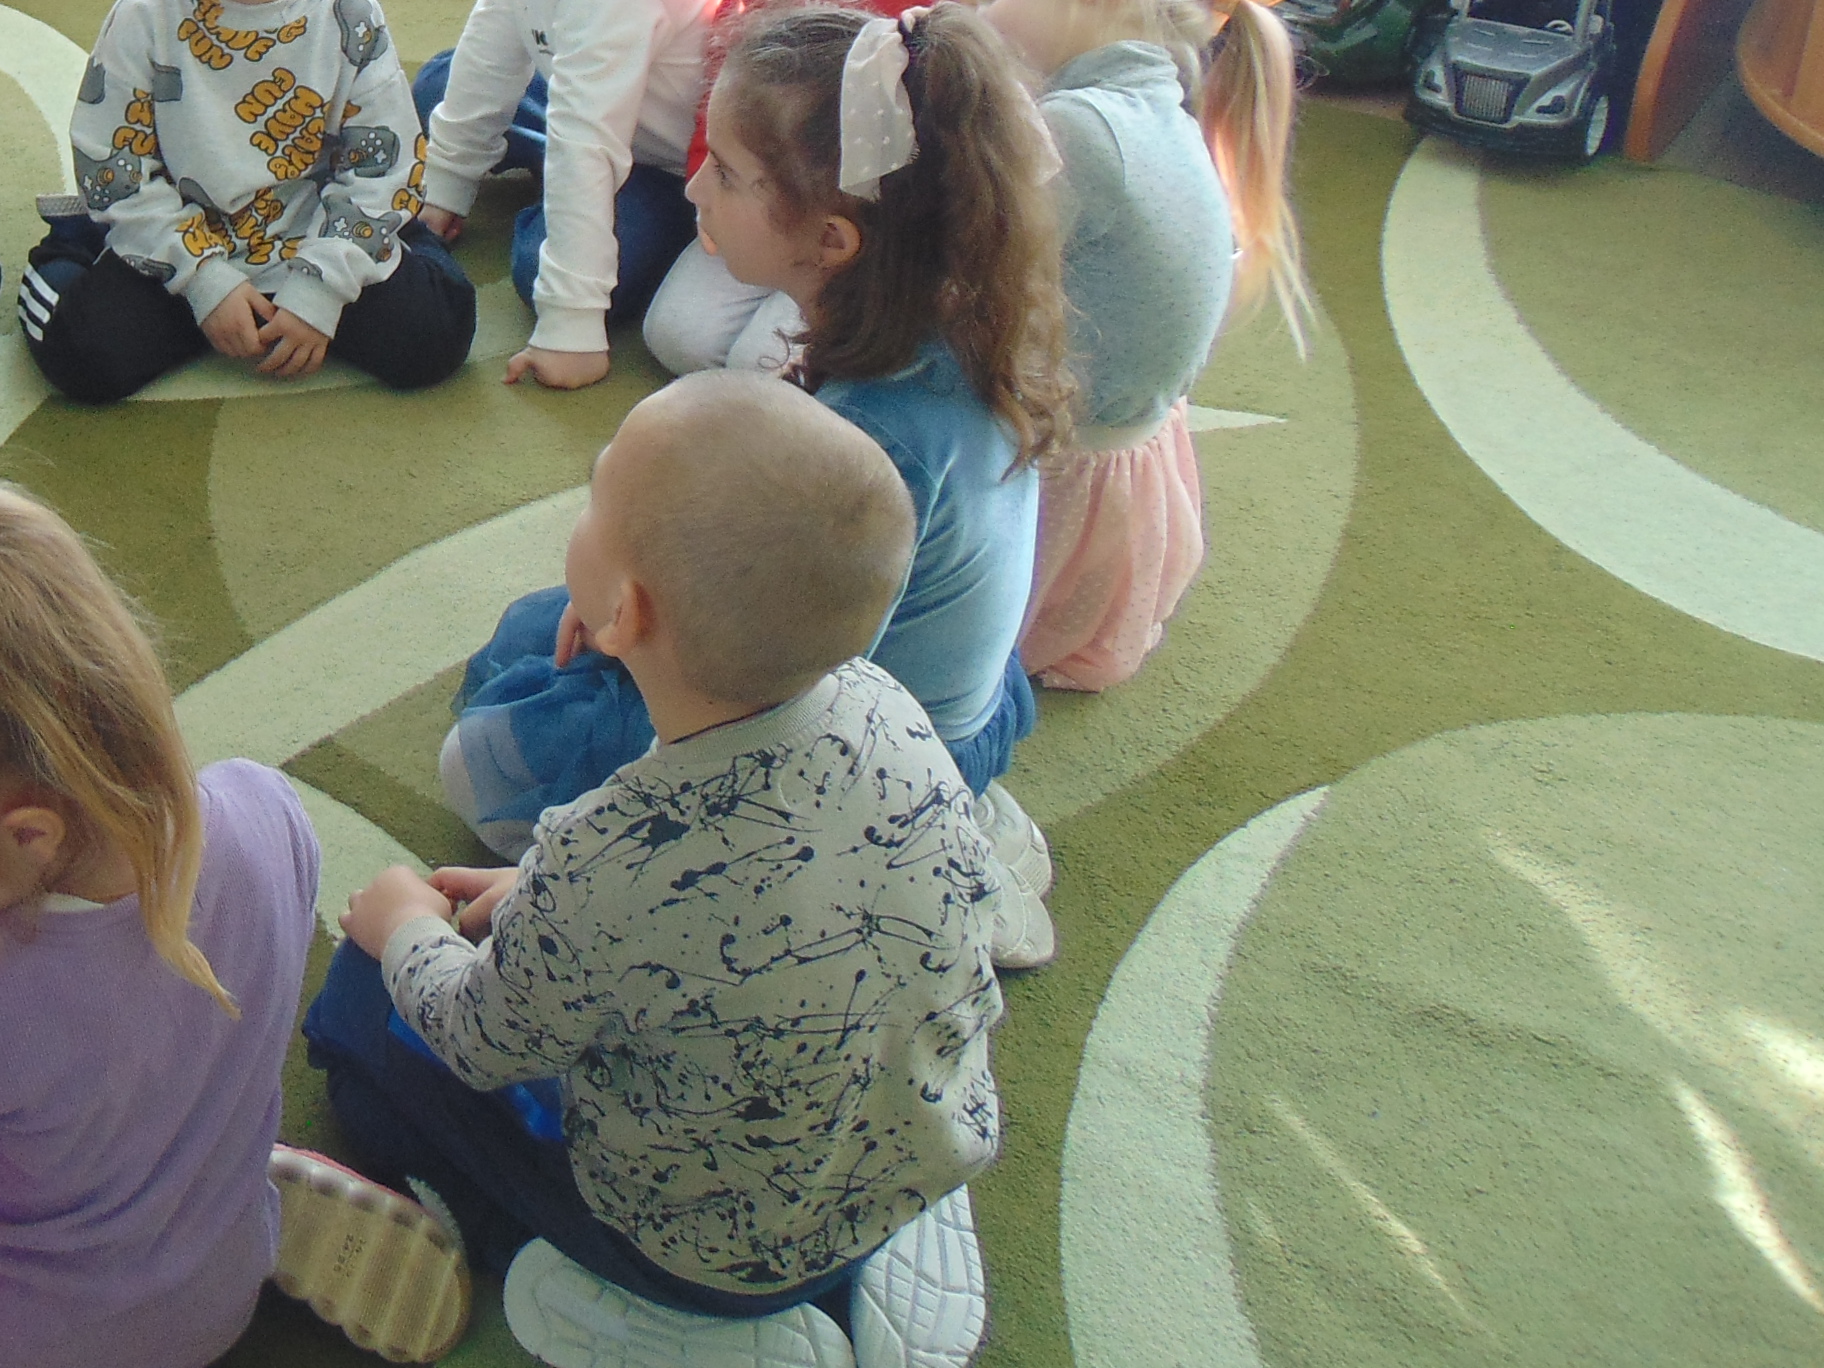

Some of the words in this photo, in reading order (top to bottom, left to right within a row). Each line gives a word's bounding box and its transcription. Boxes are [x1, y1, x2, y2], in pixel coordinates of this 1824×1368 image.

[178, 17, 233, 70] FUN
[234, 67, 296, 124] FUN
[250, 85, 323, 156] HAVE
